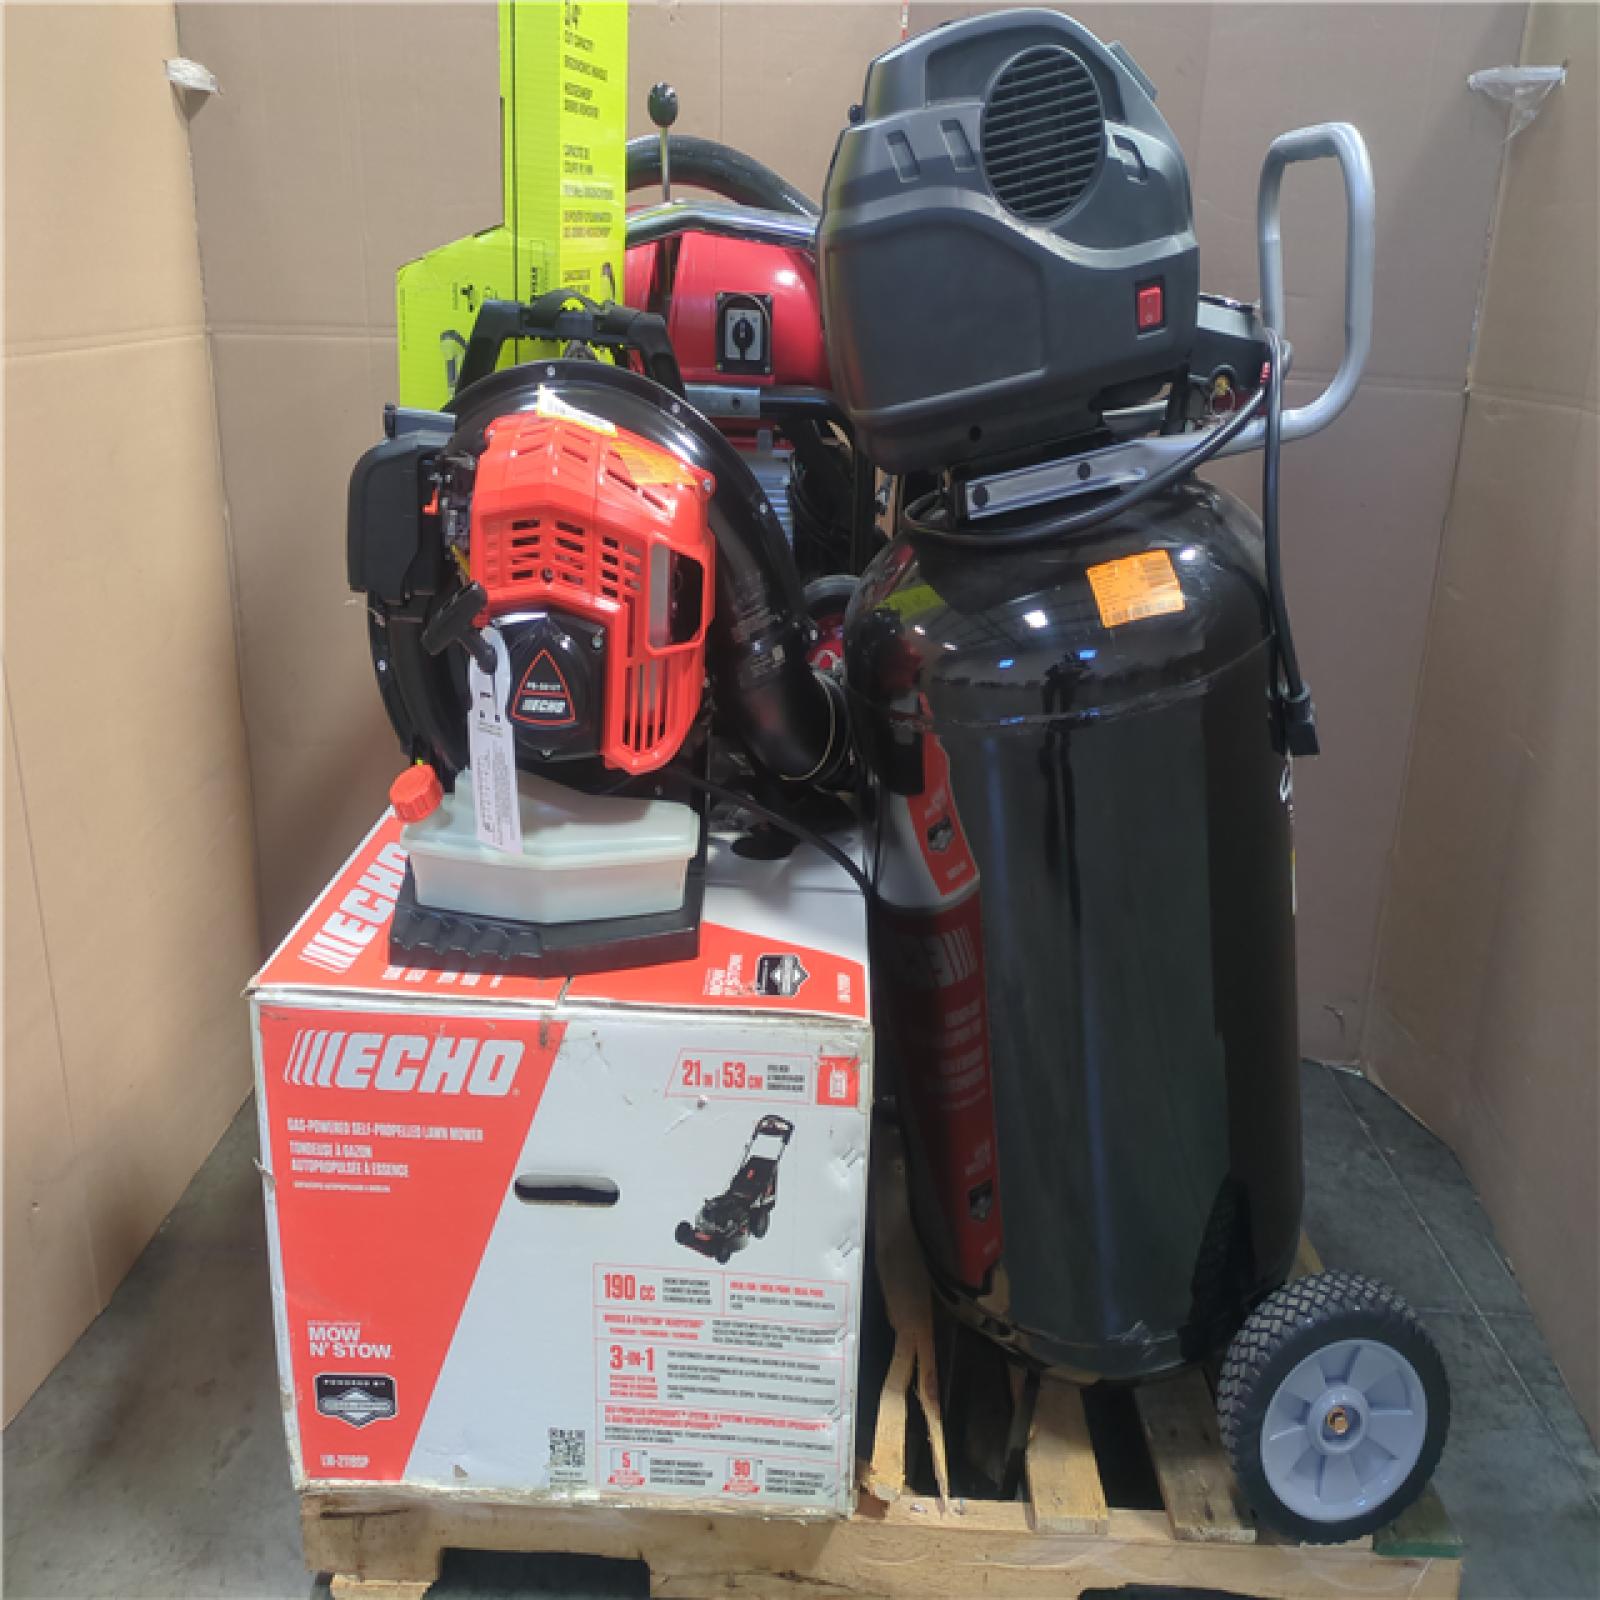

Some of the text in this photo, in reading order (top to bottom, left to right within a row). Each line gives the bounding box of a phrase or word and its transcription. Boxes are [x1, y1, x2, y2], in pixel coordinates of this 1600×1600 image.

[334, 1032, 525, 1096] ECHO
[682, 1059, 702, 1086] 21
[722, 1061, 746, 1089] 53
[604, 1273, 636, 1301] 190
[308, 1326, 361, 1342] MOW
[622, 1451, 632, 1468] 5
